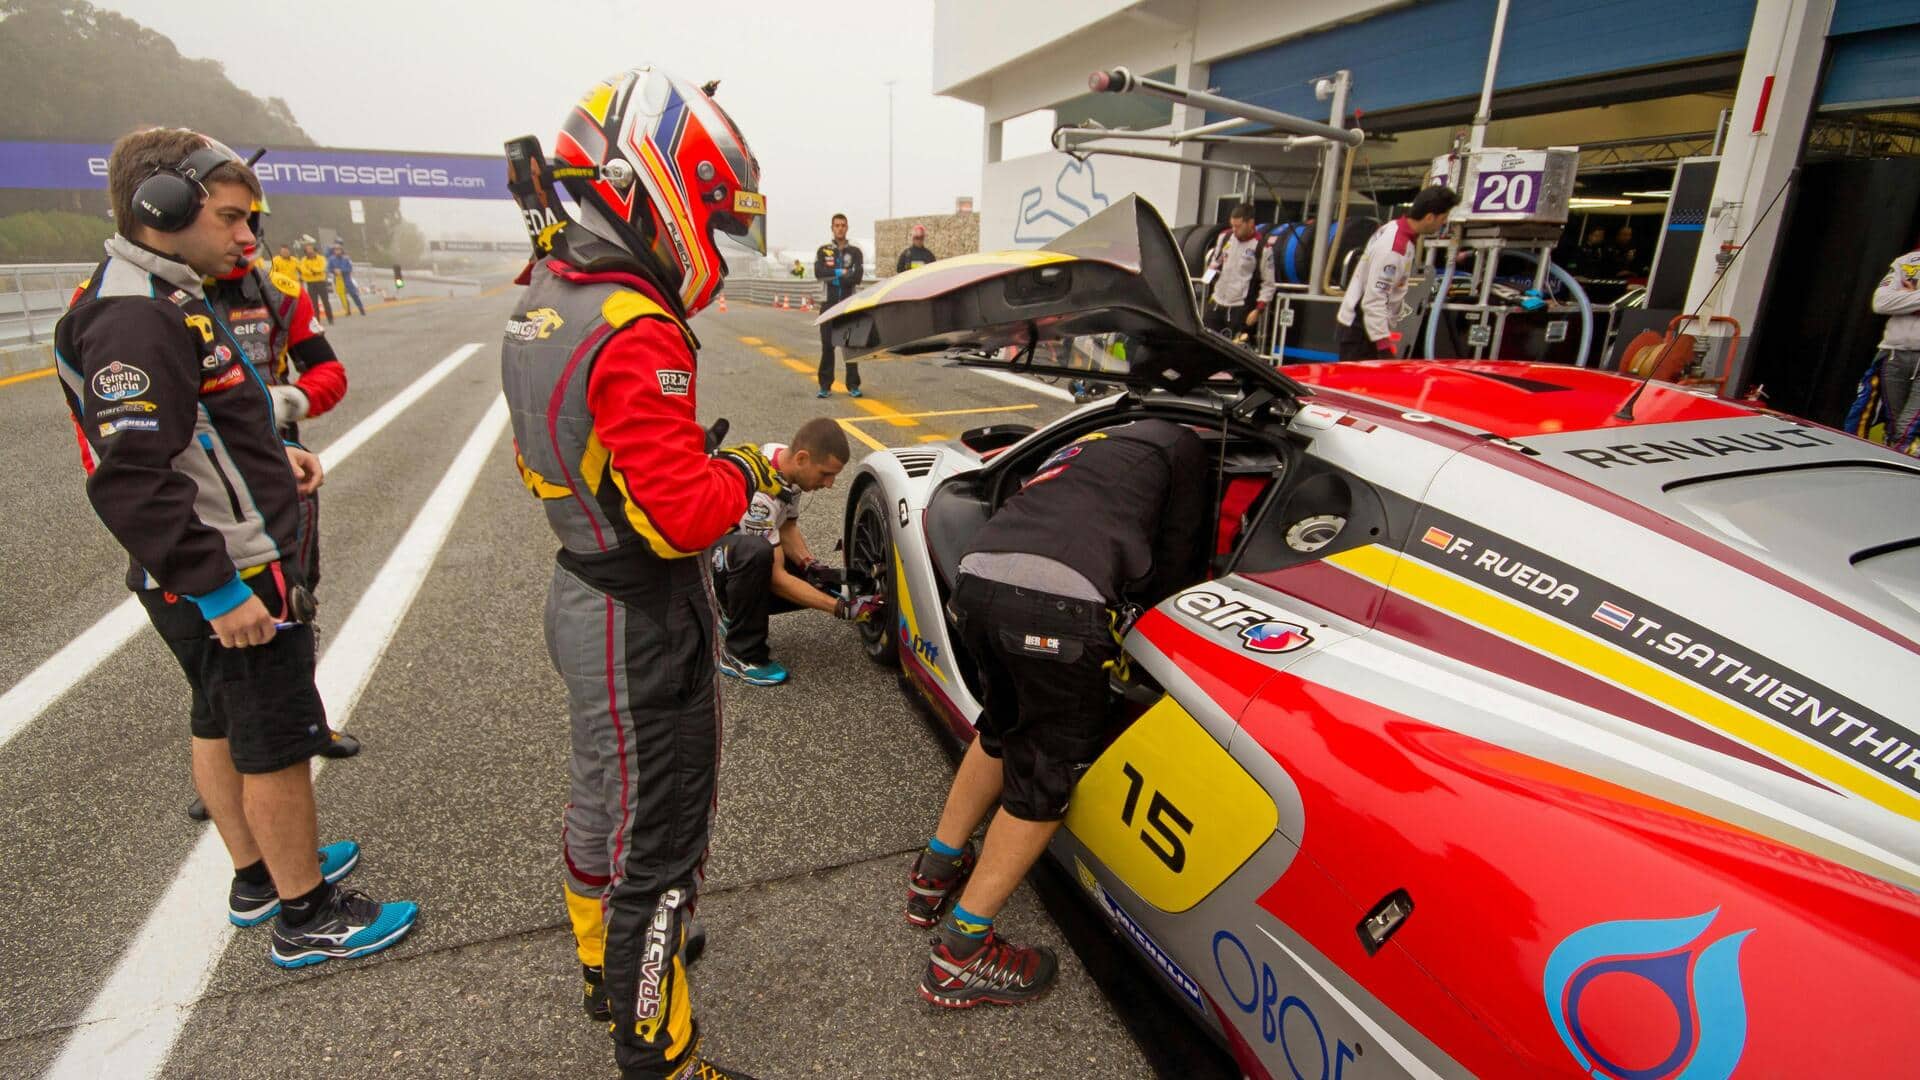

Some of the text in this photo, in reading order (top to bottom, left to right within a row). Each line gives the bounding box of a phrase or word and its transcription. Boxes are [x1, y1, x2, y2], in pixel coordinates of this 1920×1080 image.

[1480, 174, 1533, 211] 20
[234, 323, 256, 335] elf
[99, 371, 141, 386] Estrella
[103, 381, 139, 395] Galicia
[1563, 428, 1834, 469] RENAULT
[1447, 537, 1580, 606] F. RUEDA
[1175, 591, 1274, 630] elf
[912, 634, 940, 667] ptt
[1121, 761, 1194, 873] 15
[1115, 907, 1200, 999] MICHELIN
